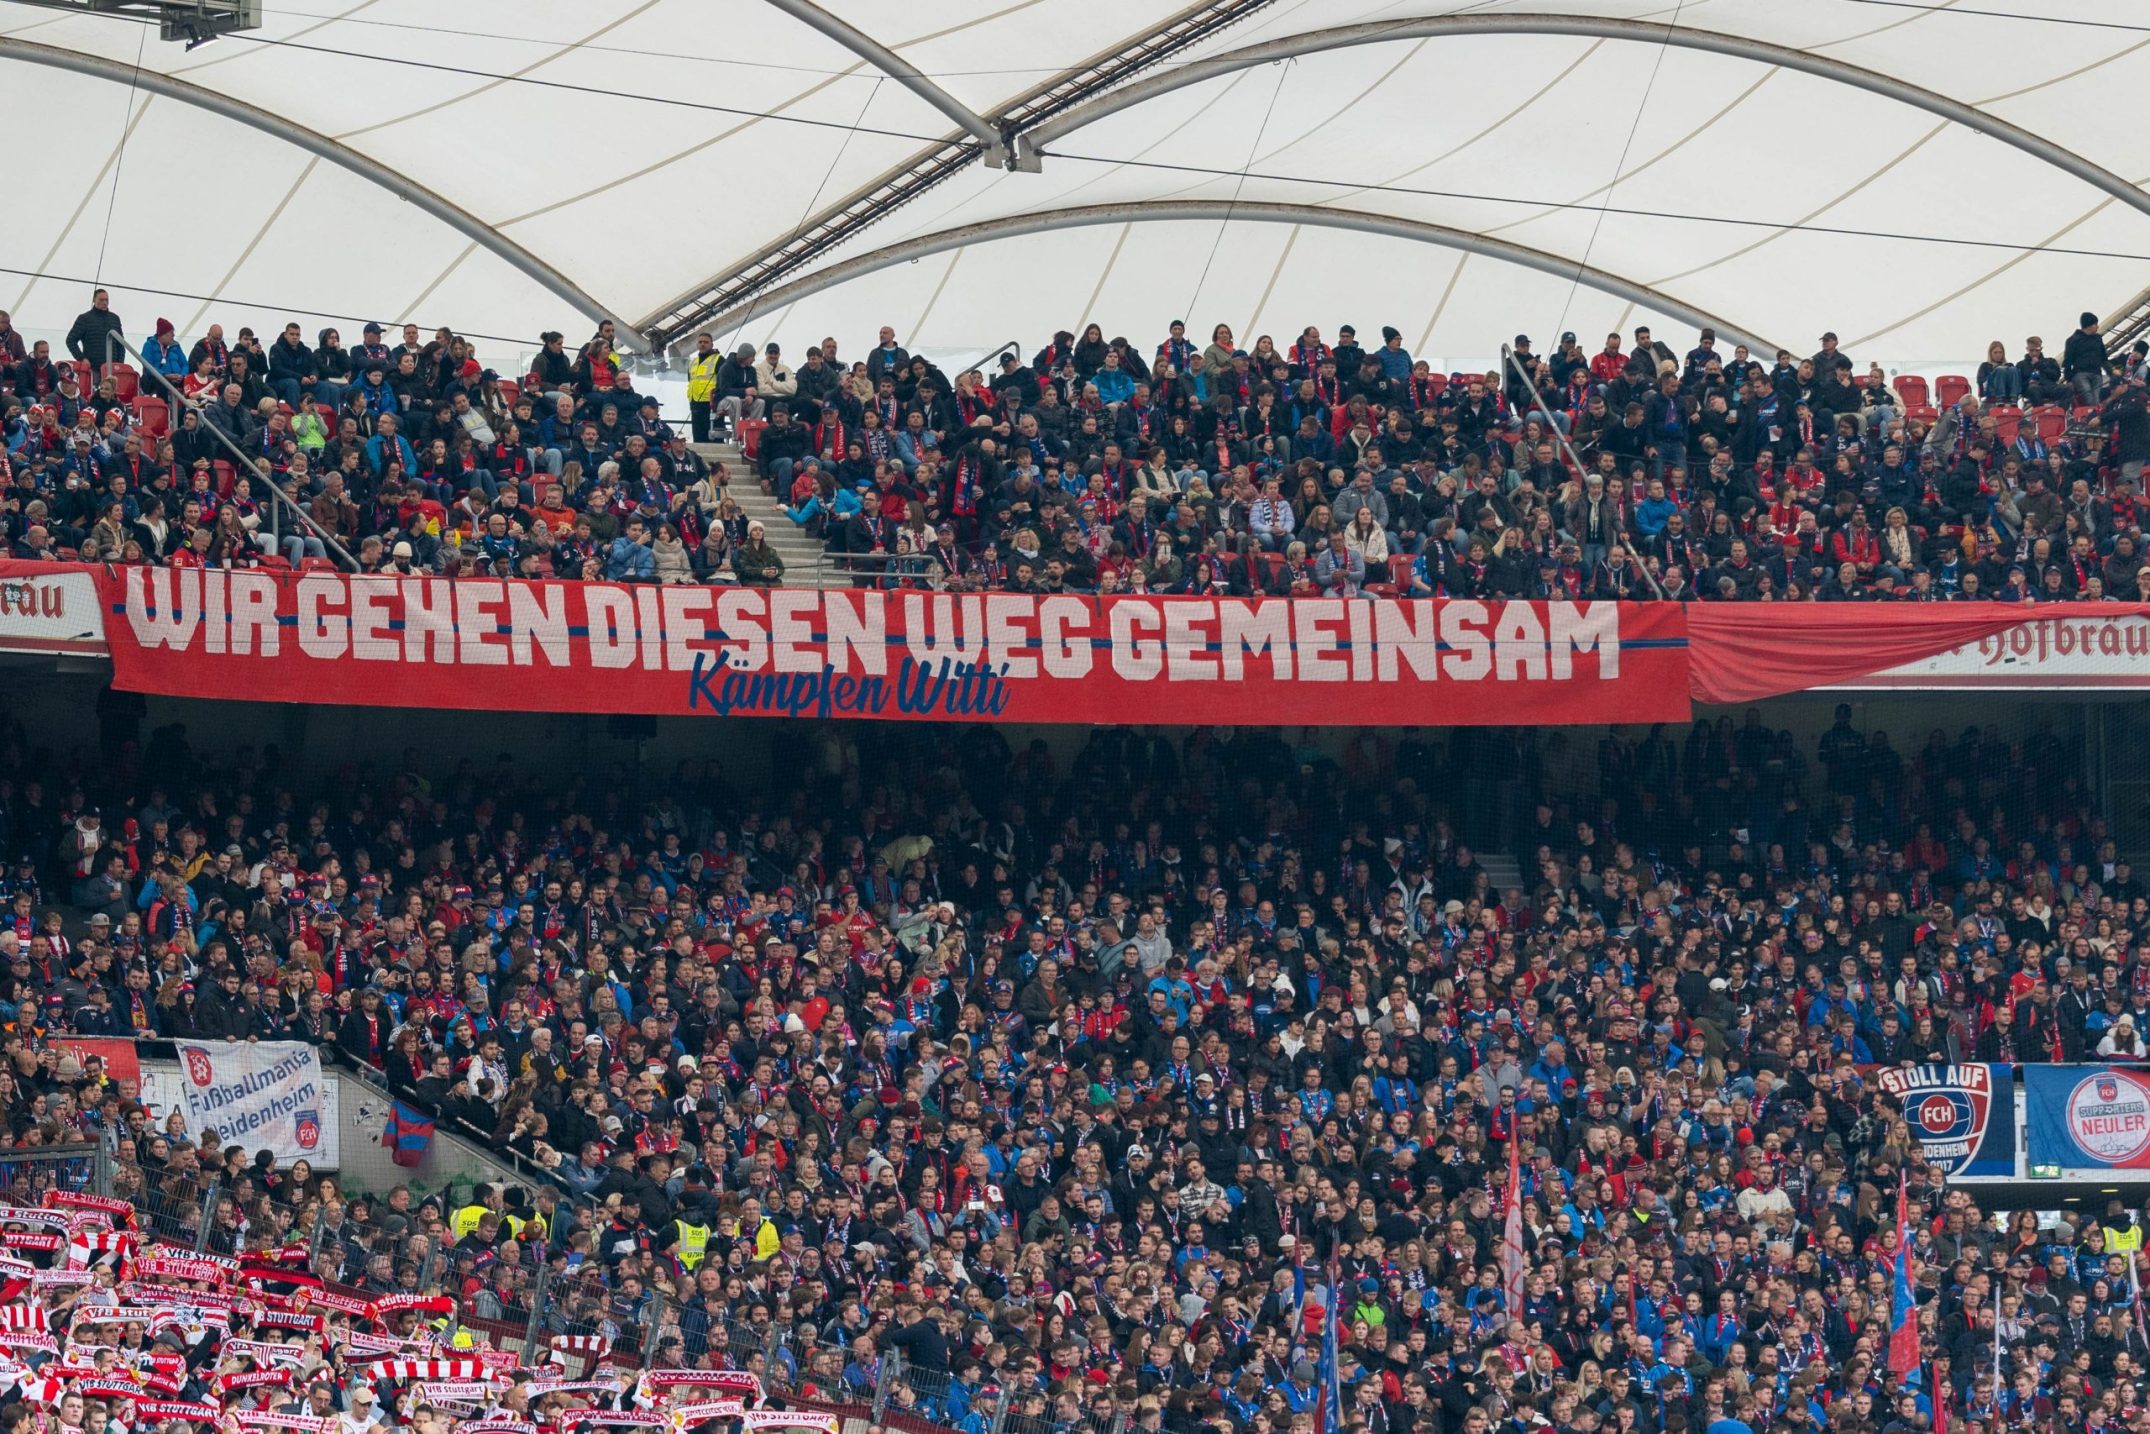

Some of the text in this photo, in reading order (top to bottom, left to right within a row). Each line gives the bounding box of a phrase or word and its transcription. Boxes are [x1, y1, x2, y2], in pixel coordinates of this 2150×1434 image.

[126, 566, 1619, 682] WIR GEHEN DIESEN WEG GEMEINSAM
[689, 650, 1012, 719] Kämpfen Witti
[189, 1050, 312, 1117] Fußballmania
[1882, 1065, 1984, 1093] STOLL AUF
[1924, 1106, 1952, 1124] FCH
[2082, 1114, 2146, 1136] NEULER
[299, 1127, 317, 1141] FCH
[1923, 1142, 1970, 1158] IDENHEIM
[267, 1313, 317, 1327] STUTTGART
[97, 1380, 141, 1395] STUTTGAR
[425, 1384, 483, 1394] VfB Stuttgart
[434, 1400, 457, 1410] VfB
